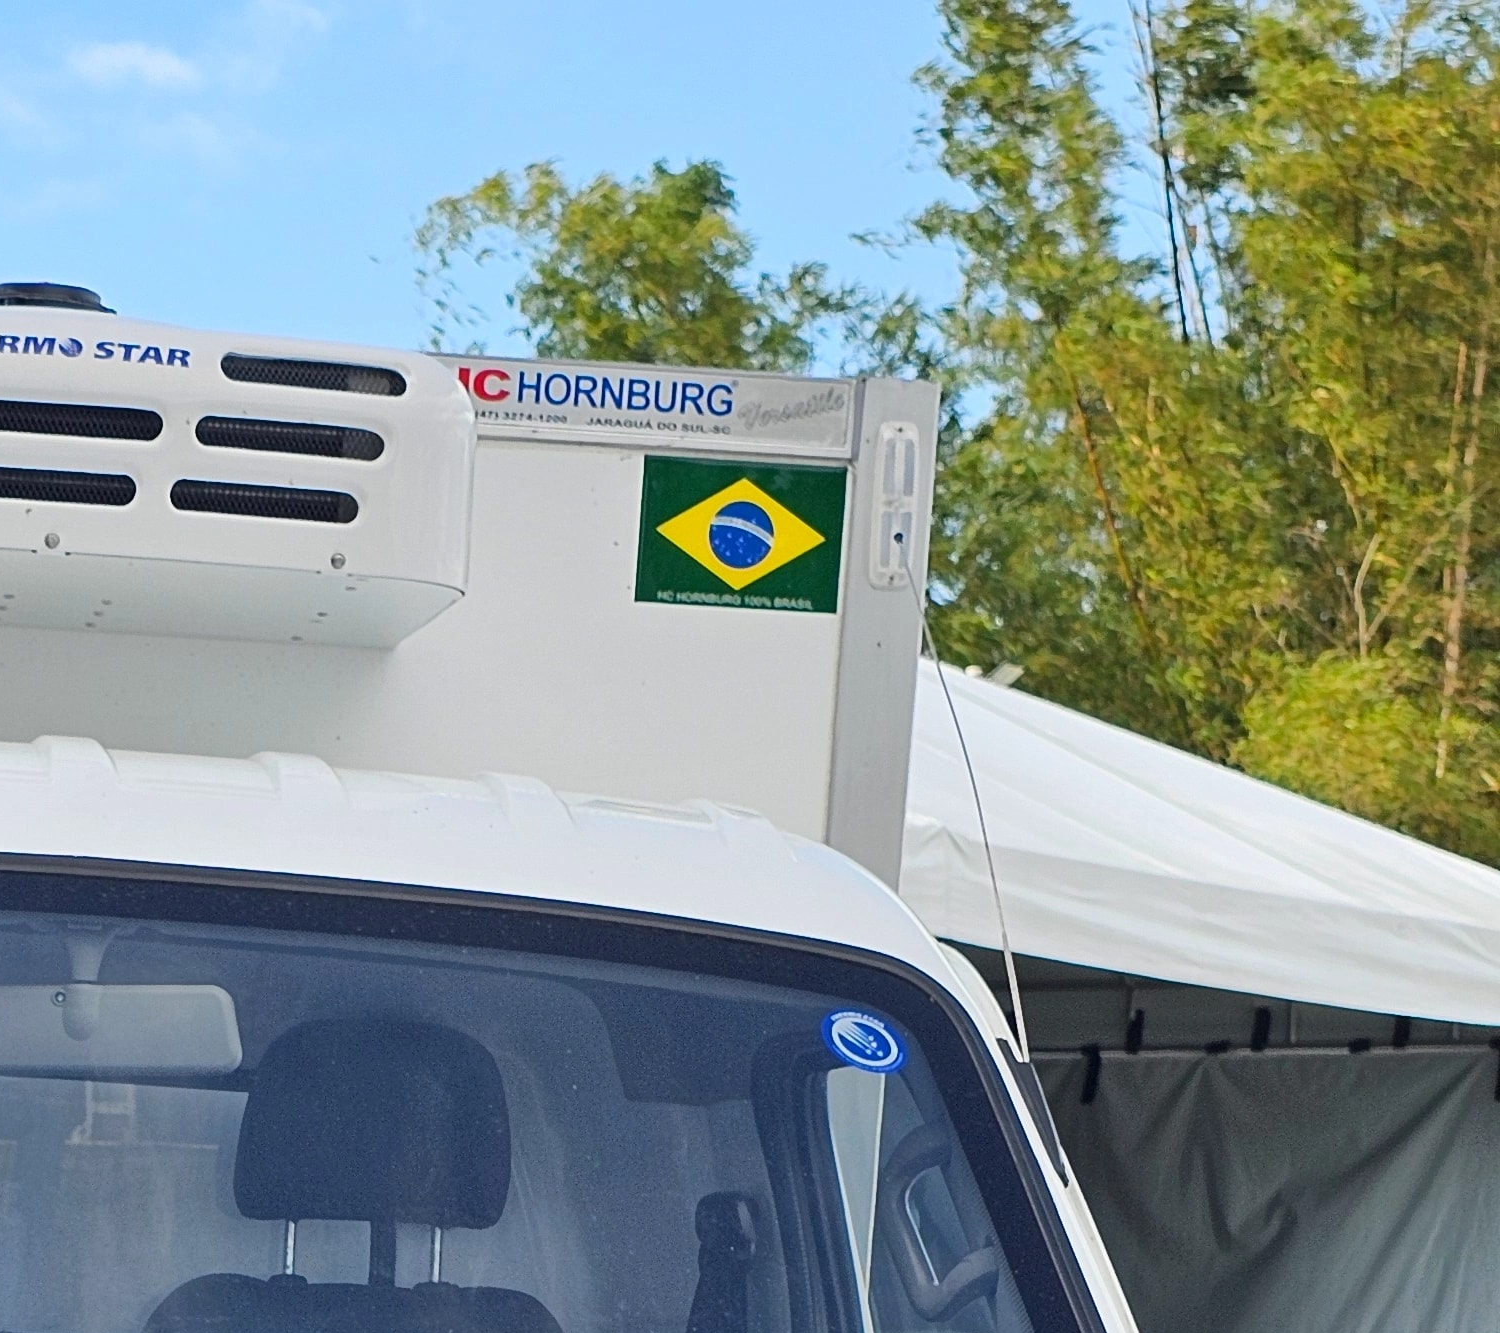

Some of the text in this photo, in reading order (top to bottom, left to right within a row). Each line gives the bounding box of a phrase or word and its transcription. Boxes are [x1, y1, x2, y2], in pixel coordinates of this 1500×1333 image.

[93, 341, 191, 368] STAR
[516, 371, 733, 417] HORNBURG
[585, 417, 653, 430] JARAGUÁ
[657, 421, 678, 432] DO
[676, 591, 742, 606] HORNBURG
[774, 597, 813, 610] BRASIL
